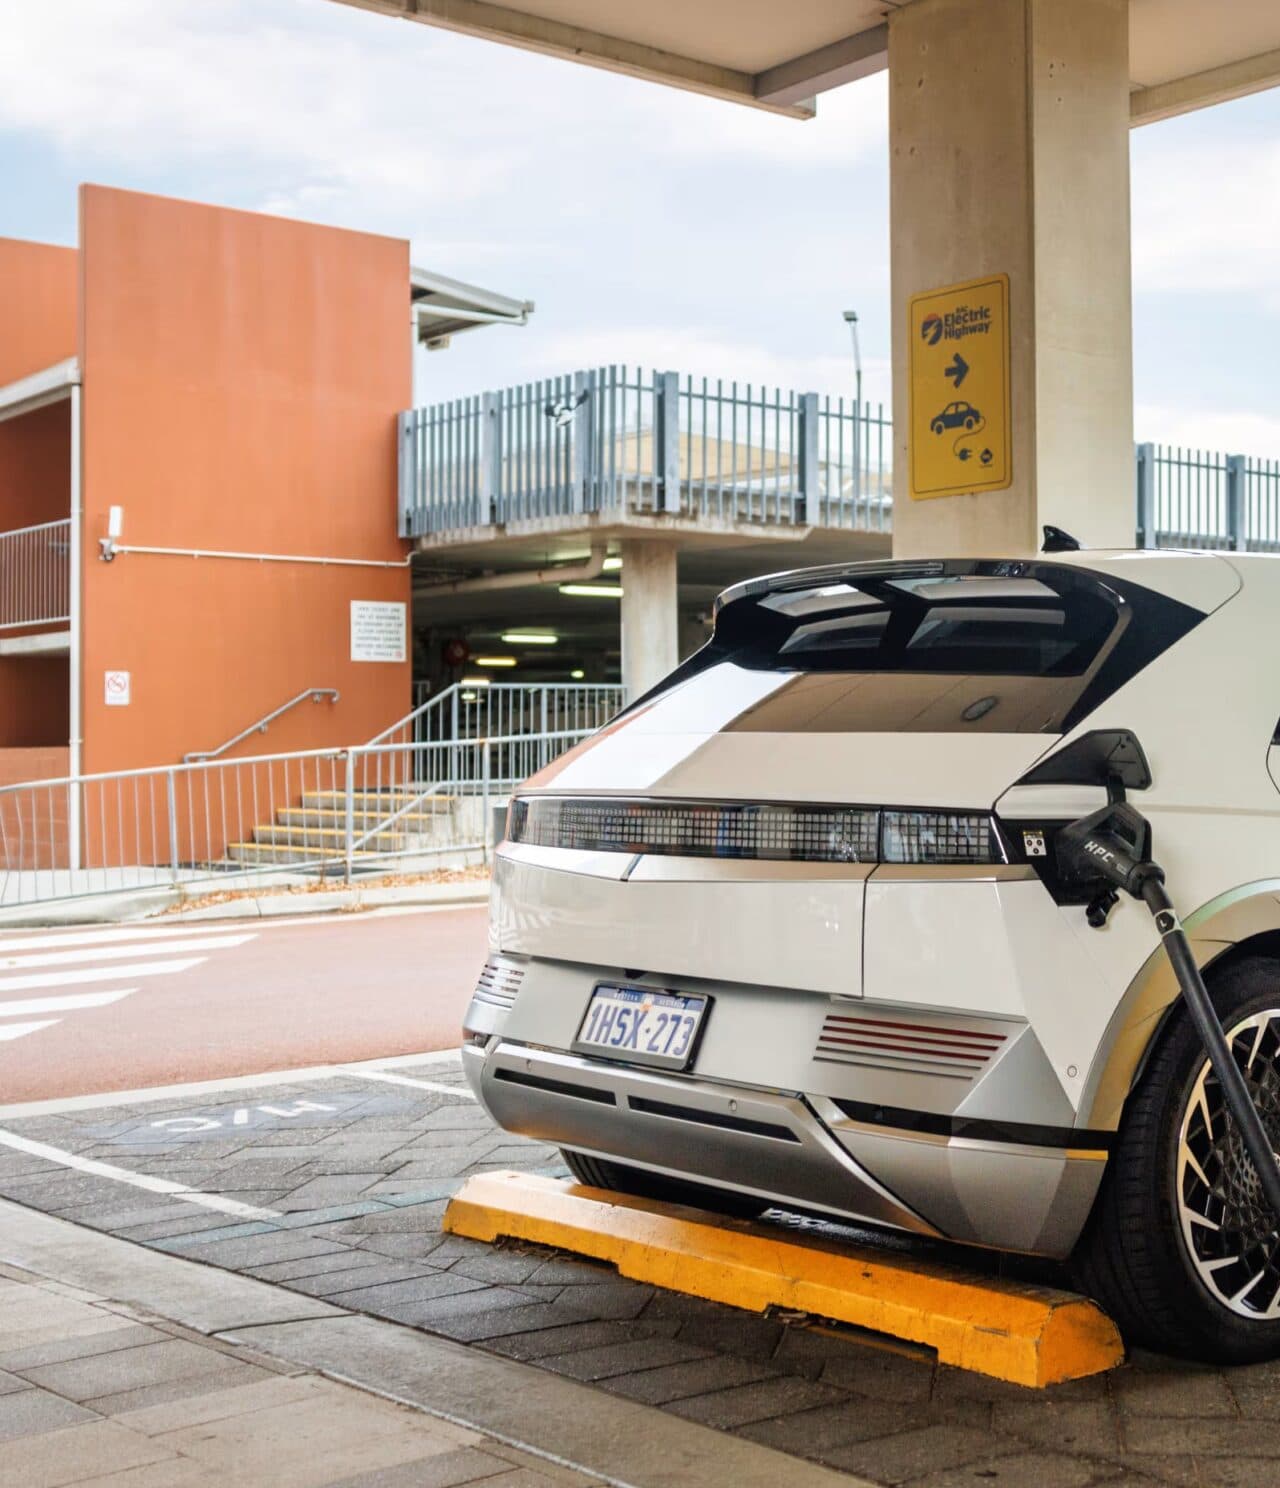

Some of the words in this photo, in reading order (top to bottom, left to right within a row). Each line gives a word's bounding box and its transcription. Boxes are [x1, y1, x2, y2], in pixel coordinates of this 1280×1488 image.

[944, 306, 990, 327] Electric
[944, 321, 992, 340] Highway
[1084, 841, 1114, 863] HPC
